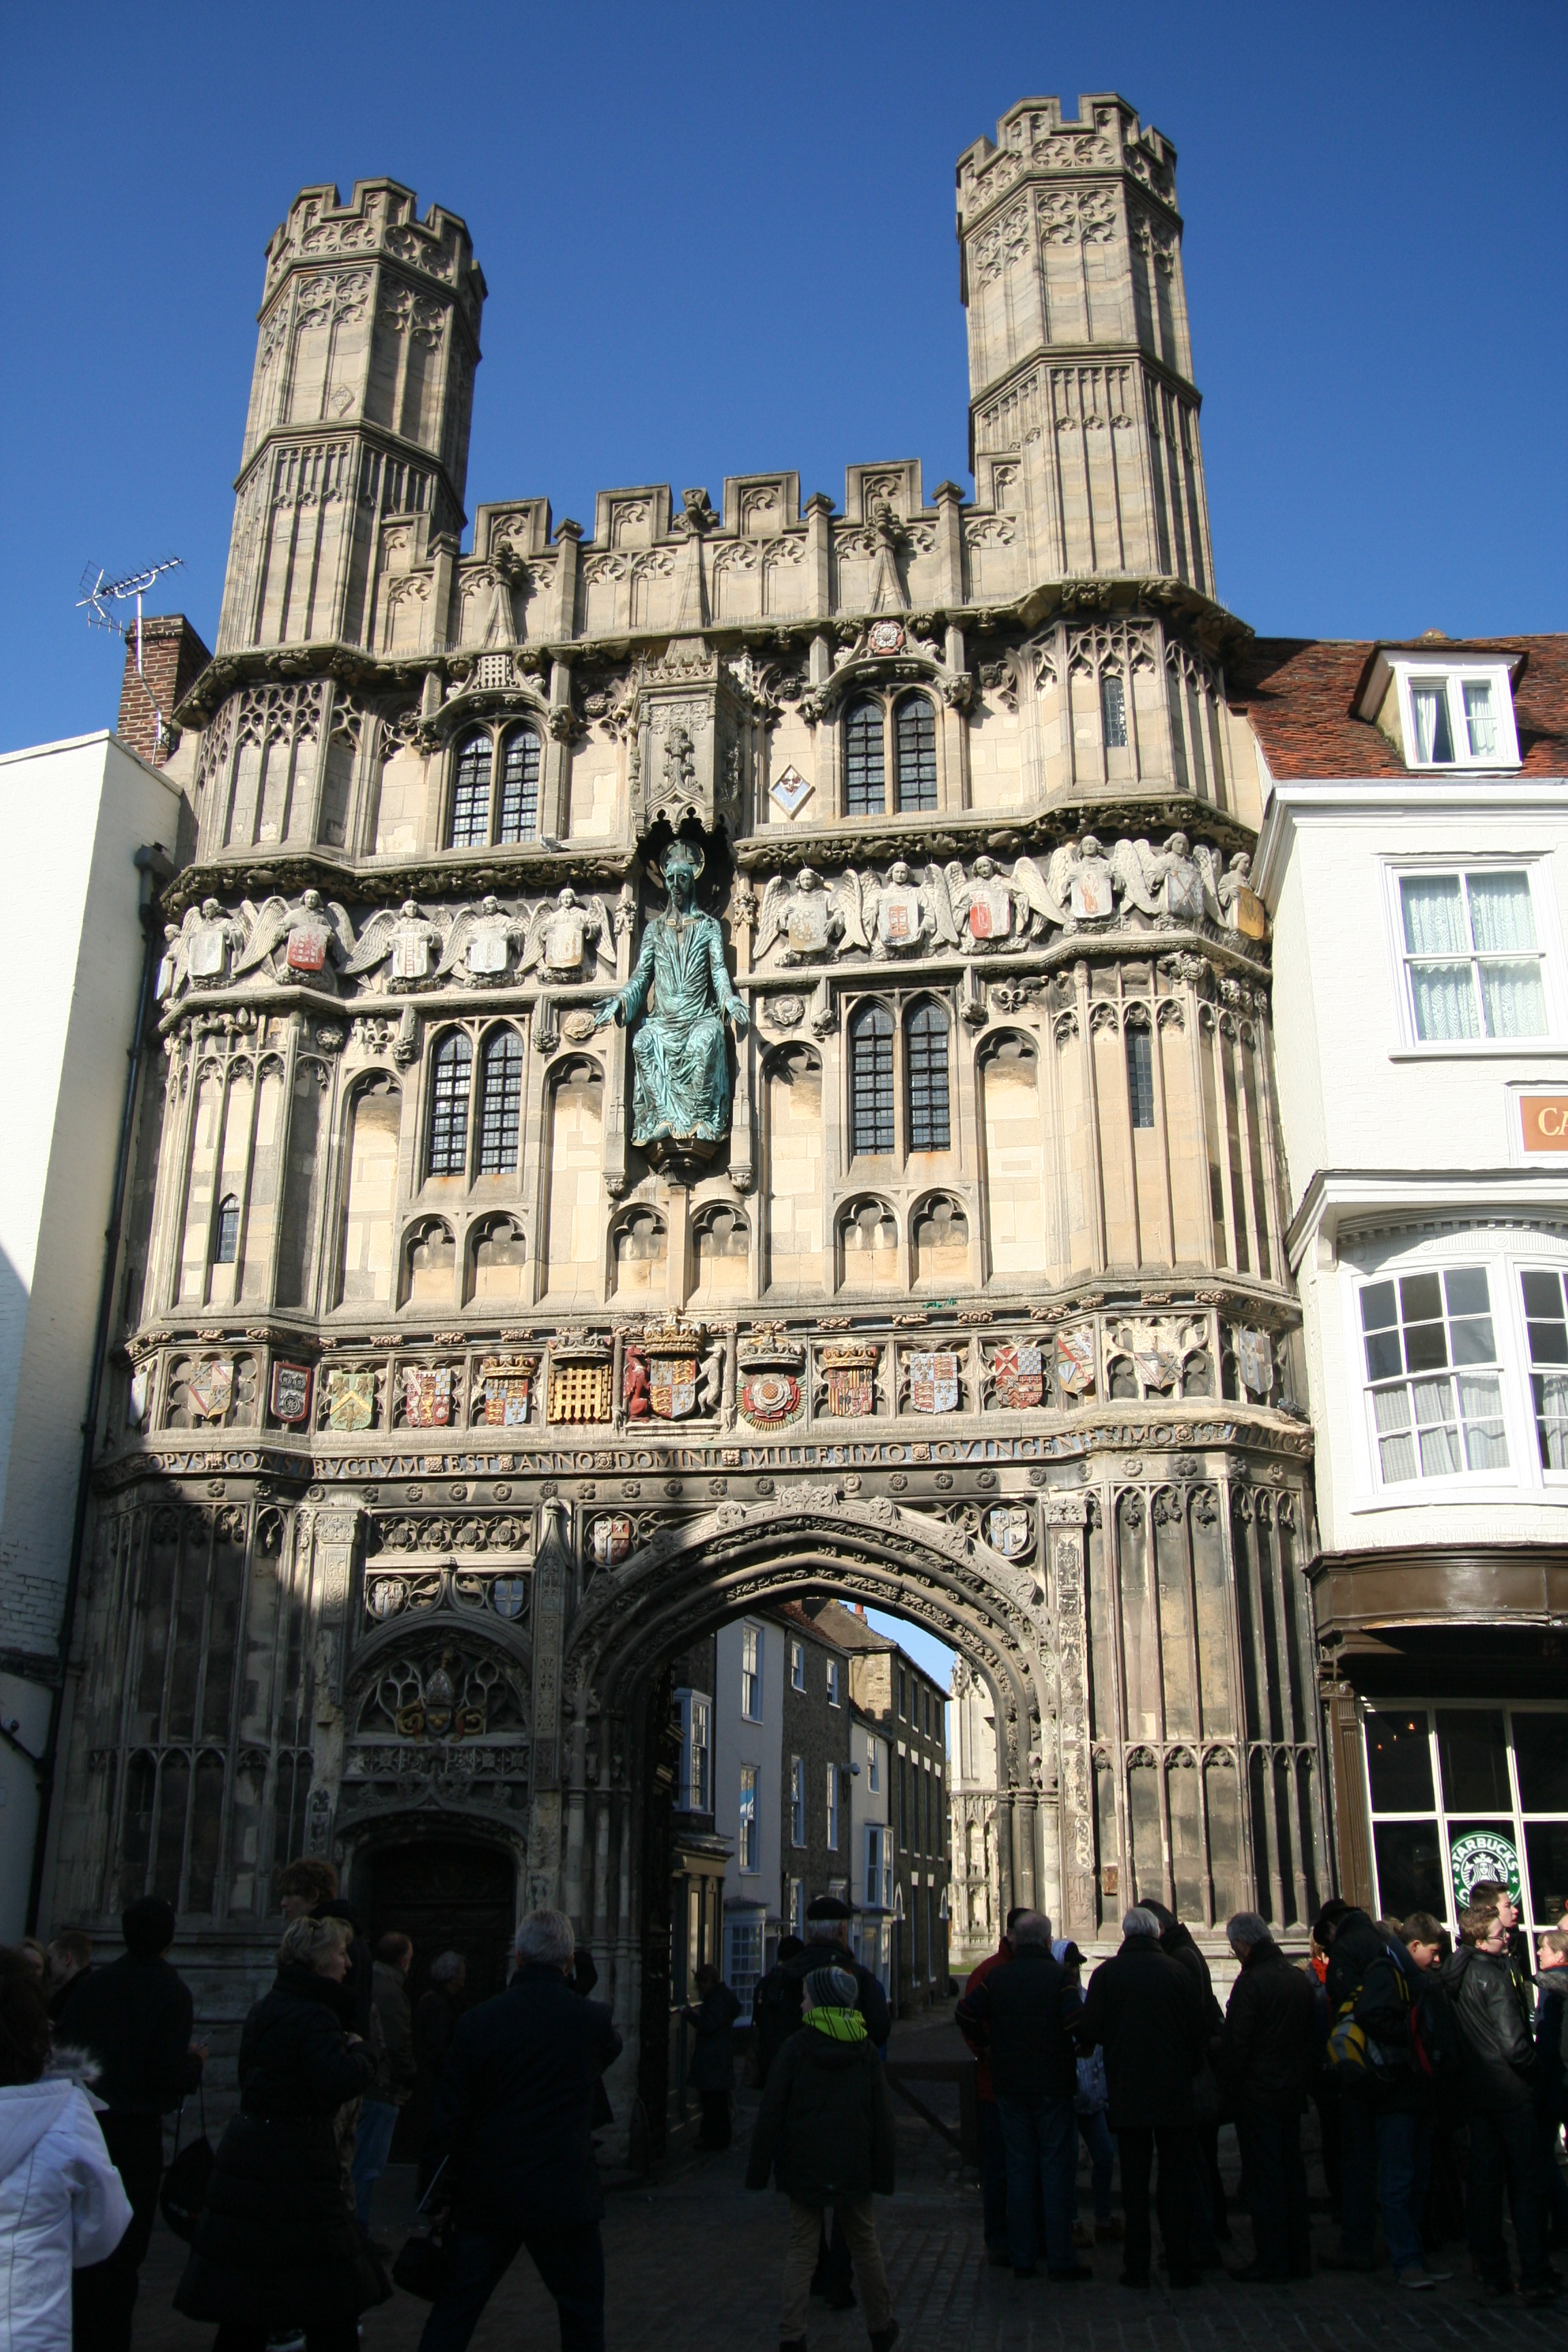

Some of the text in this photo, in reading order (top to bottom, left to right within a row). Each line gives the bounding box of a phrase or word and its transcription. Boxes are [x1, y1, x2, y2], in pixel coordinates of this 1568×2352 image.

[146, 1451, 206, 1471] OPVS
[223, 1451, 421, 1477] CONSTRVCTVM
[446, 1454, 495, 1472] EST
[518, 1452, 595, 1471] ANNO
[614, 1450, 718, 1469] DOMINI
[748, 1443, 906, 1466] MILLESIMO
[934, 1425, 1172, 1460] QVINGENTESIMO
[1452, 1838, 1518, 1872] STARBUCKS
